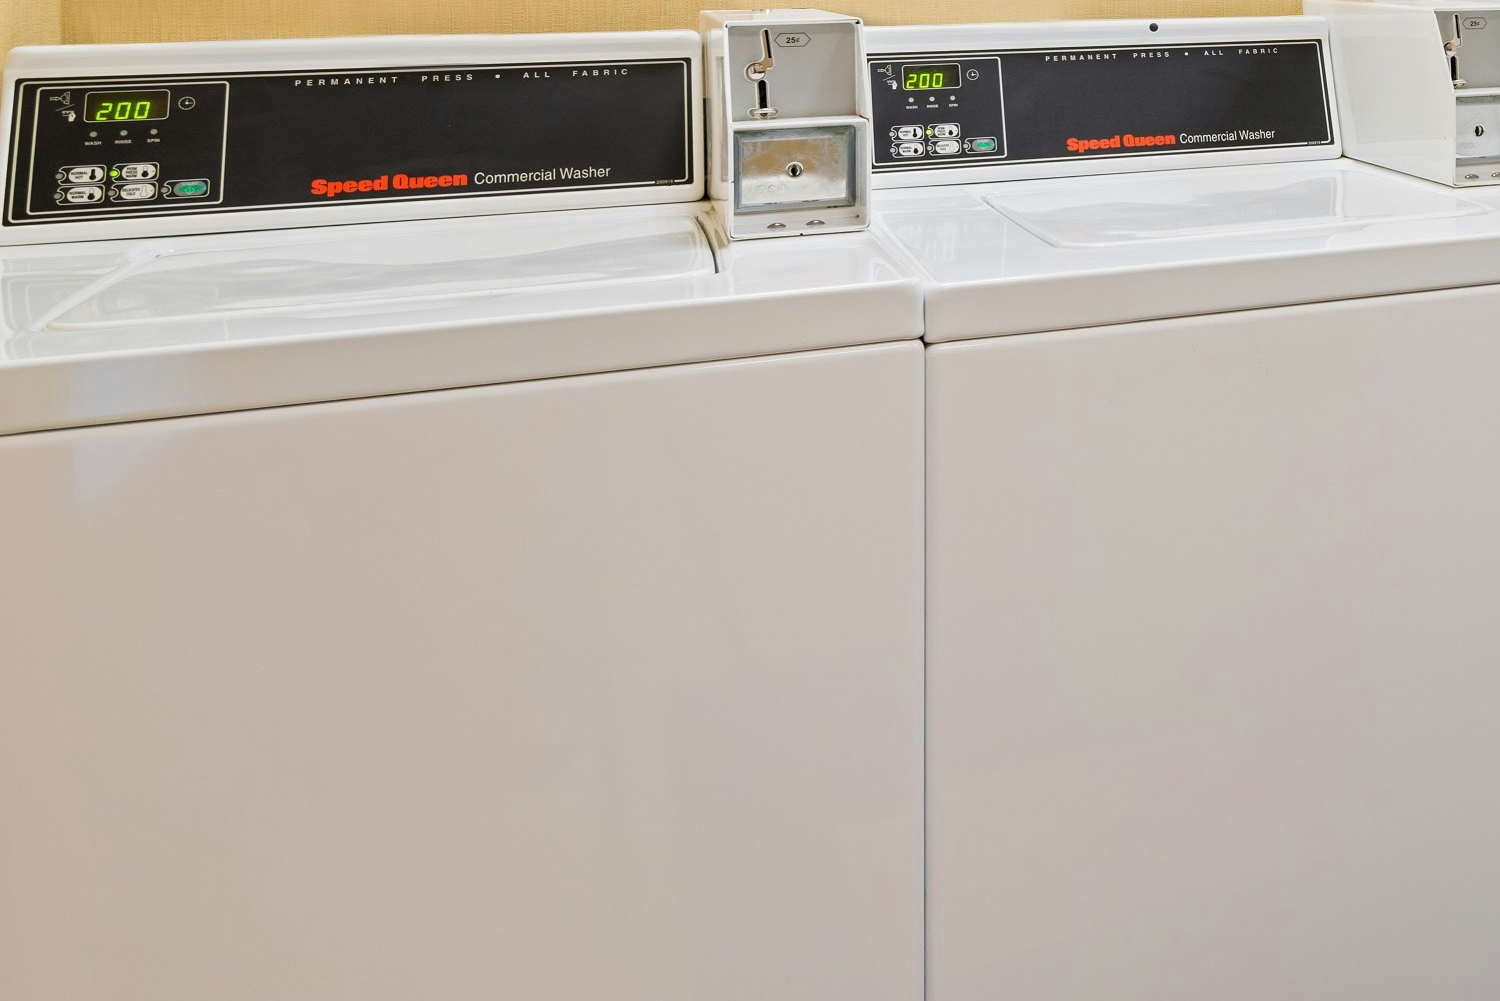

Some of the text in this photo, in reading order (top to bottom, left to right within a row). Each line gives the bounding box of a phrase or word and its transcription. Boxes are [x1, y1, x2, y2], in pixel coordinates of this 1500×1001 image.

[785, 36, 800, 44] 25¢
[1045, 53, 1117, 61] PERMANENT
[294, 68, 629, 87] PERMANENT PRESS ALL FABRIC
[906, 73, 943, 89] 200
[95, 101, 151, 121] 200
[1066, 129, 1275, 153] Speed Queen Commercial Washer
[310, 165, 611, 197] Speed Queen Commercial Washer
